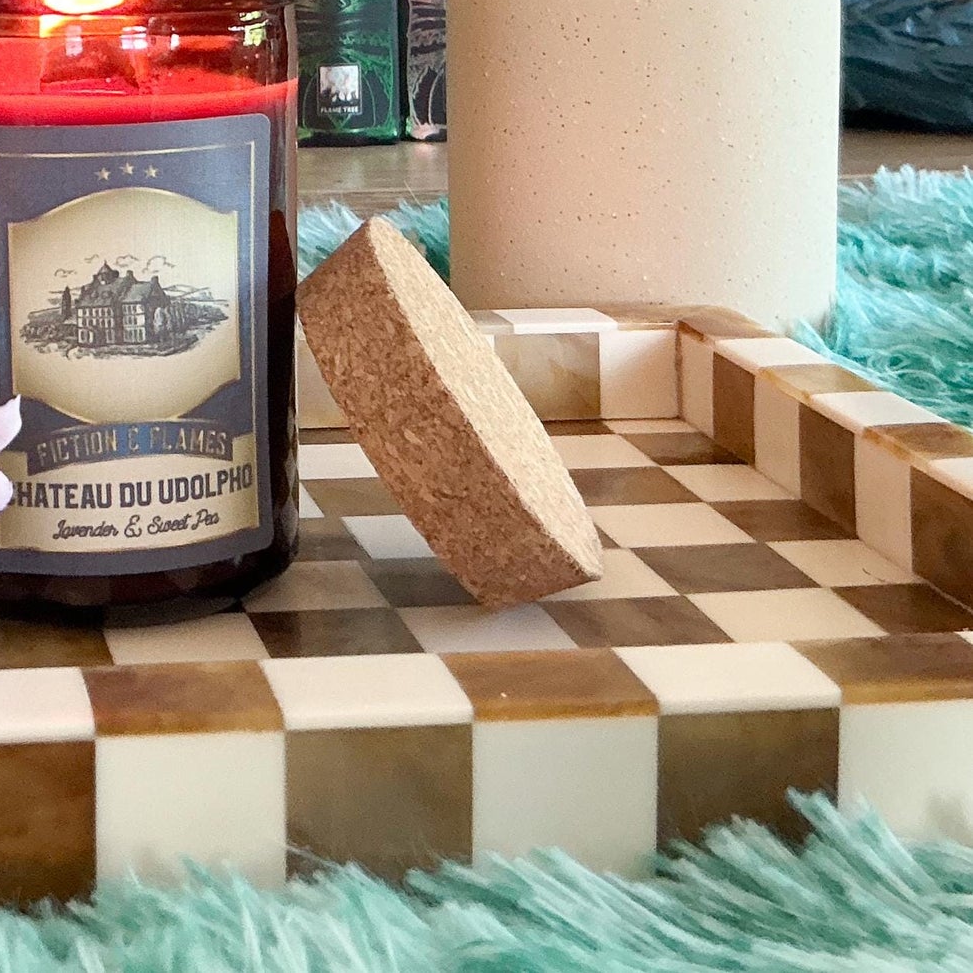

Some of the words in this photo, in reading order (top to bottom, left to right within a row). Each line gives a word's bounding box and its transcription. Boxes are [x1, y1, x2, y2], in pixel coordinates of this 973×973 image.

[321, 106, 342, 114] FLAME
[36, 428, 118, 467] FICTION
[149, 426, 226, 454] FLAMES
[8, 481, 112, 509] HATEAU
[119, 480, 152, 508] DU
[158, 463, 253, 505] UDOLPHO
[52, 519, 119, 540] Lavender
[124, 515, 142, 538] &
[147, 514, 190, 535] Sweet
[191, 508, 219, 531] Pea
